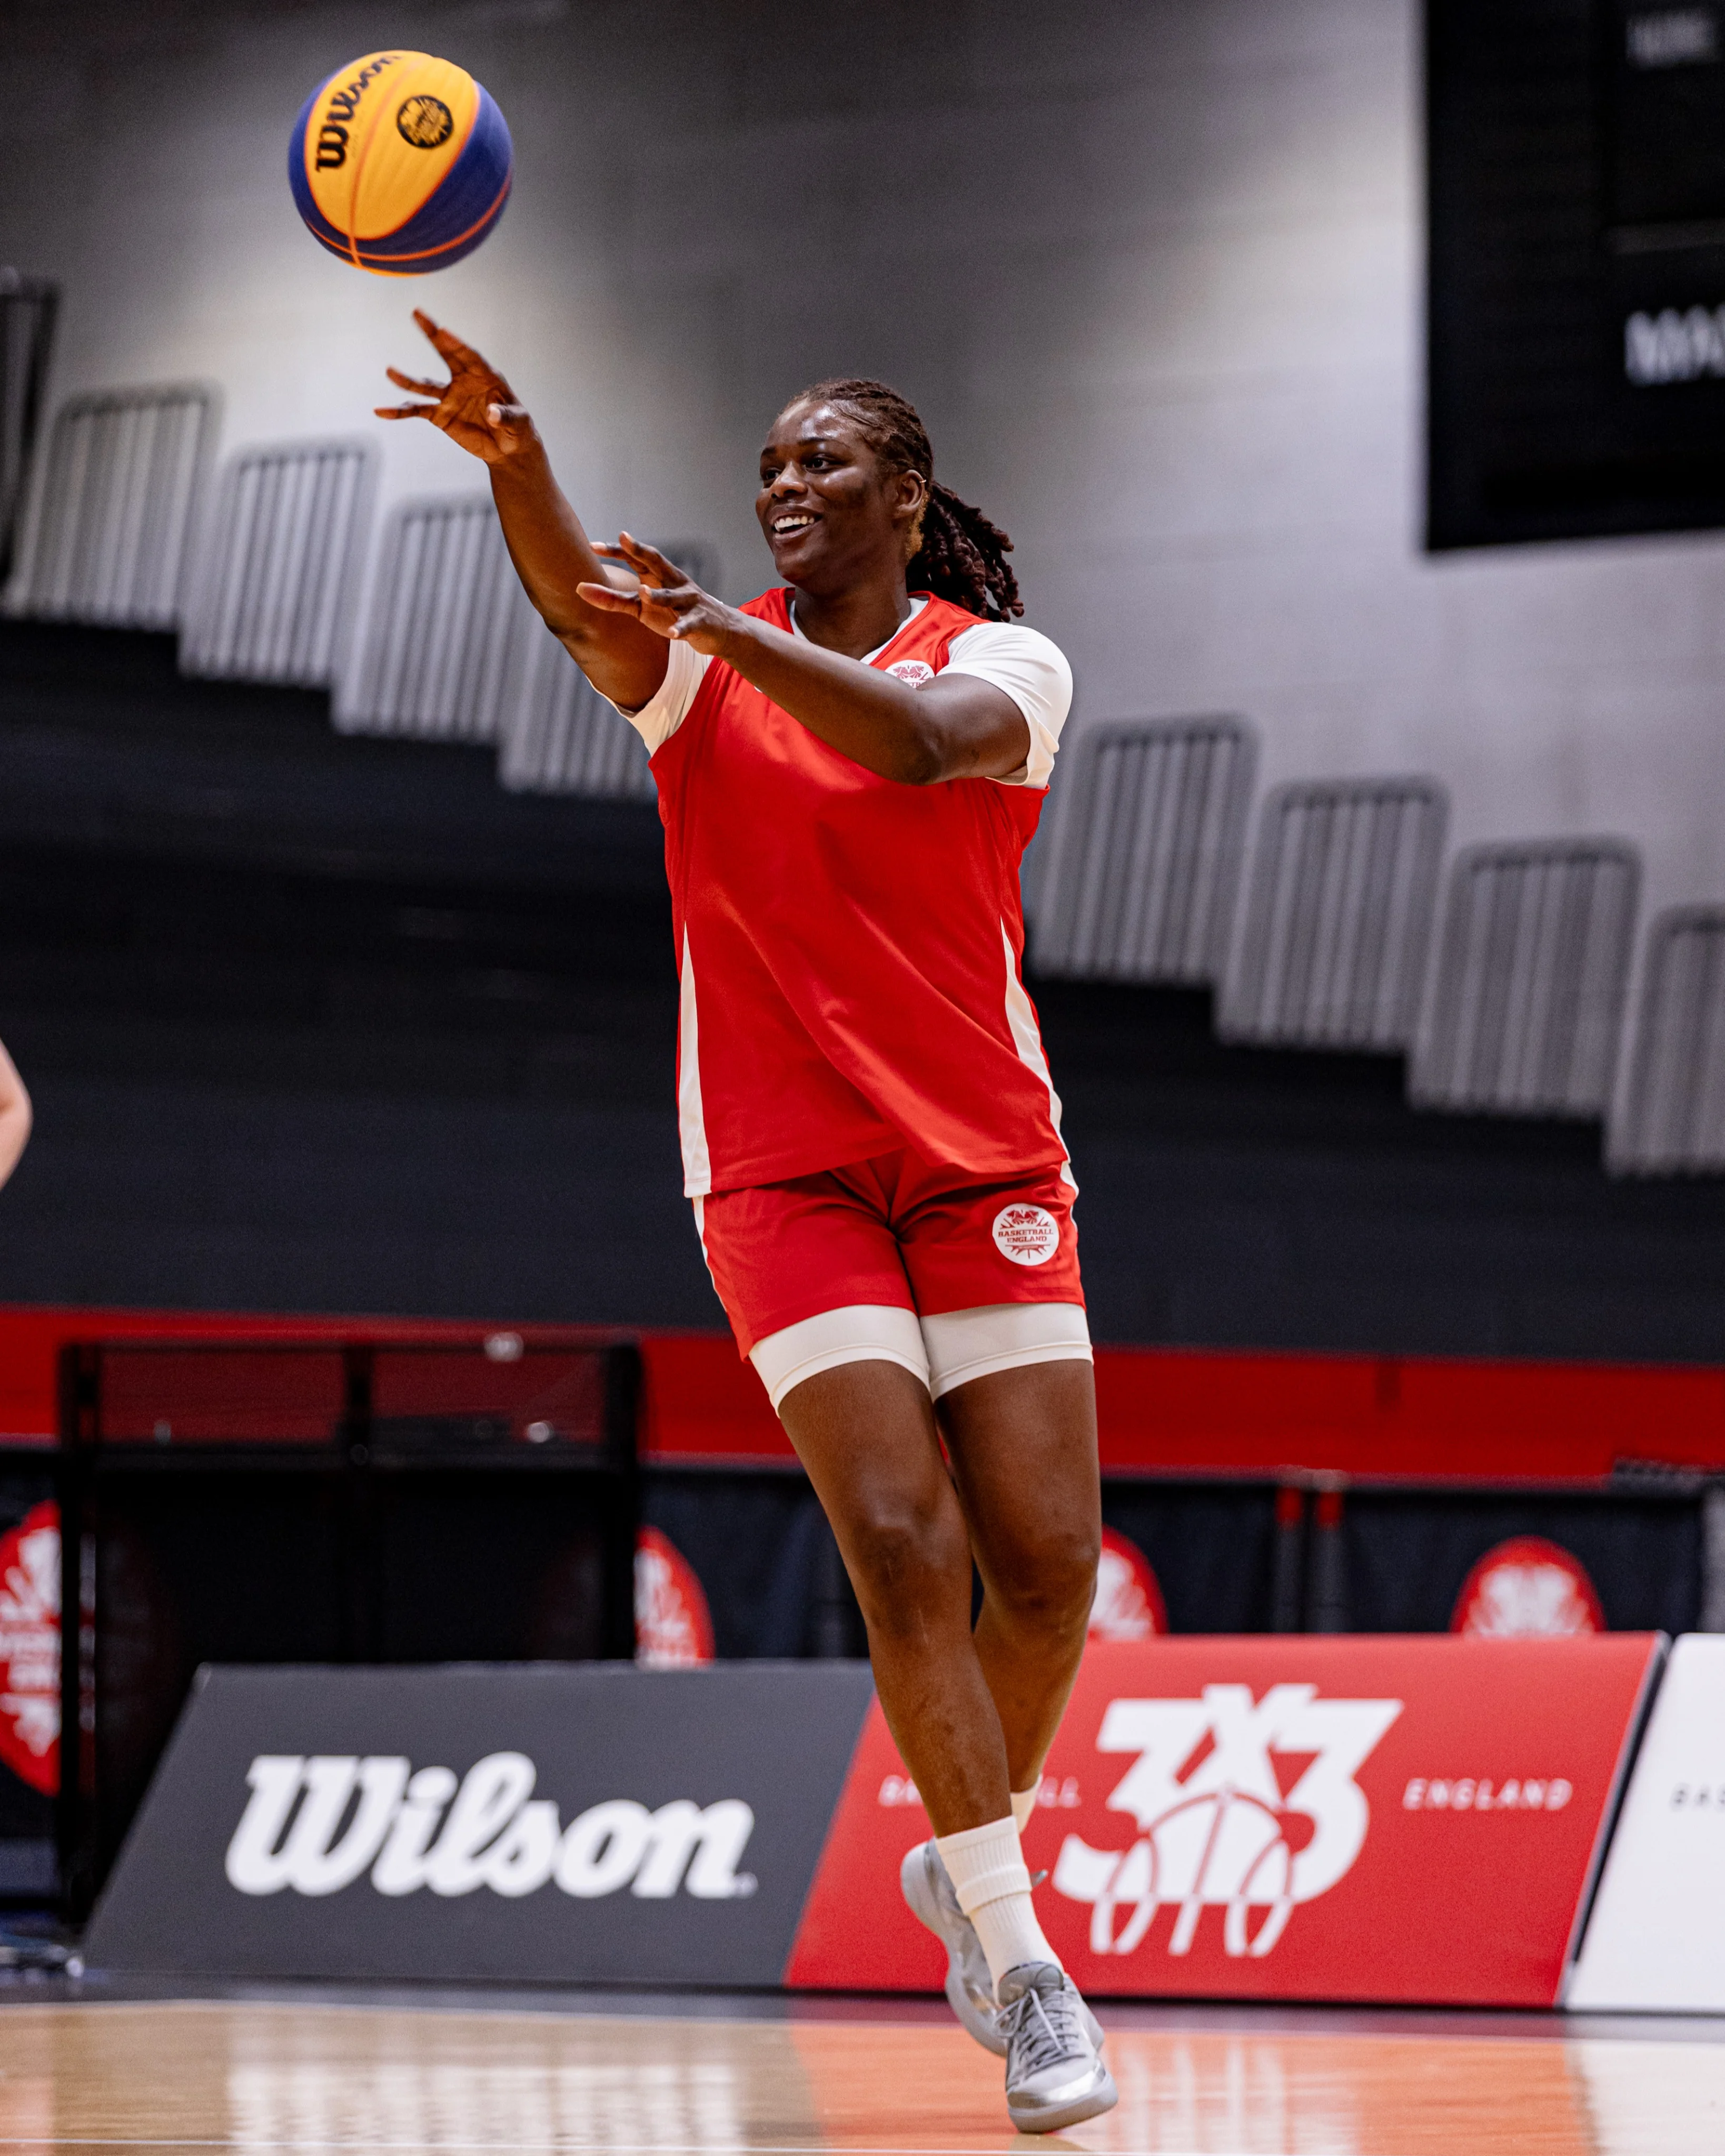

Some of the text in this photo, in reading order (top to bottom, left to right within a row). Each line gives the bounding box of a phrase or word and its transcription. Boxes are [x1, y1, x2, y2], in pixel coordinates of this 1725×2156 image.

[315, 55, 401, 173] Wilson
[998, 1229, 1053, 1237] BASKETBALL
[225, 1751, 755, 1897] Wilson
[1403, 1777, 1572, 1810] ENGLAND
